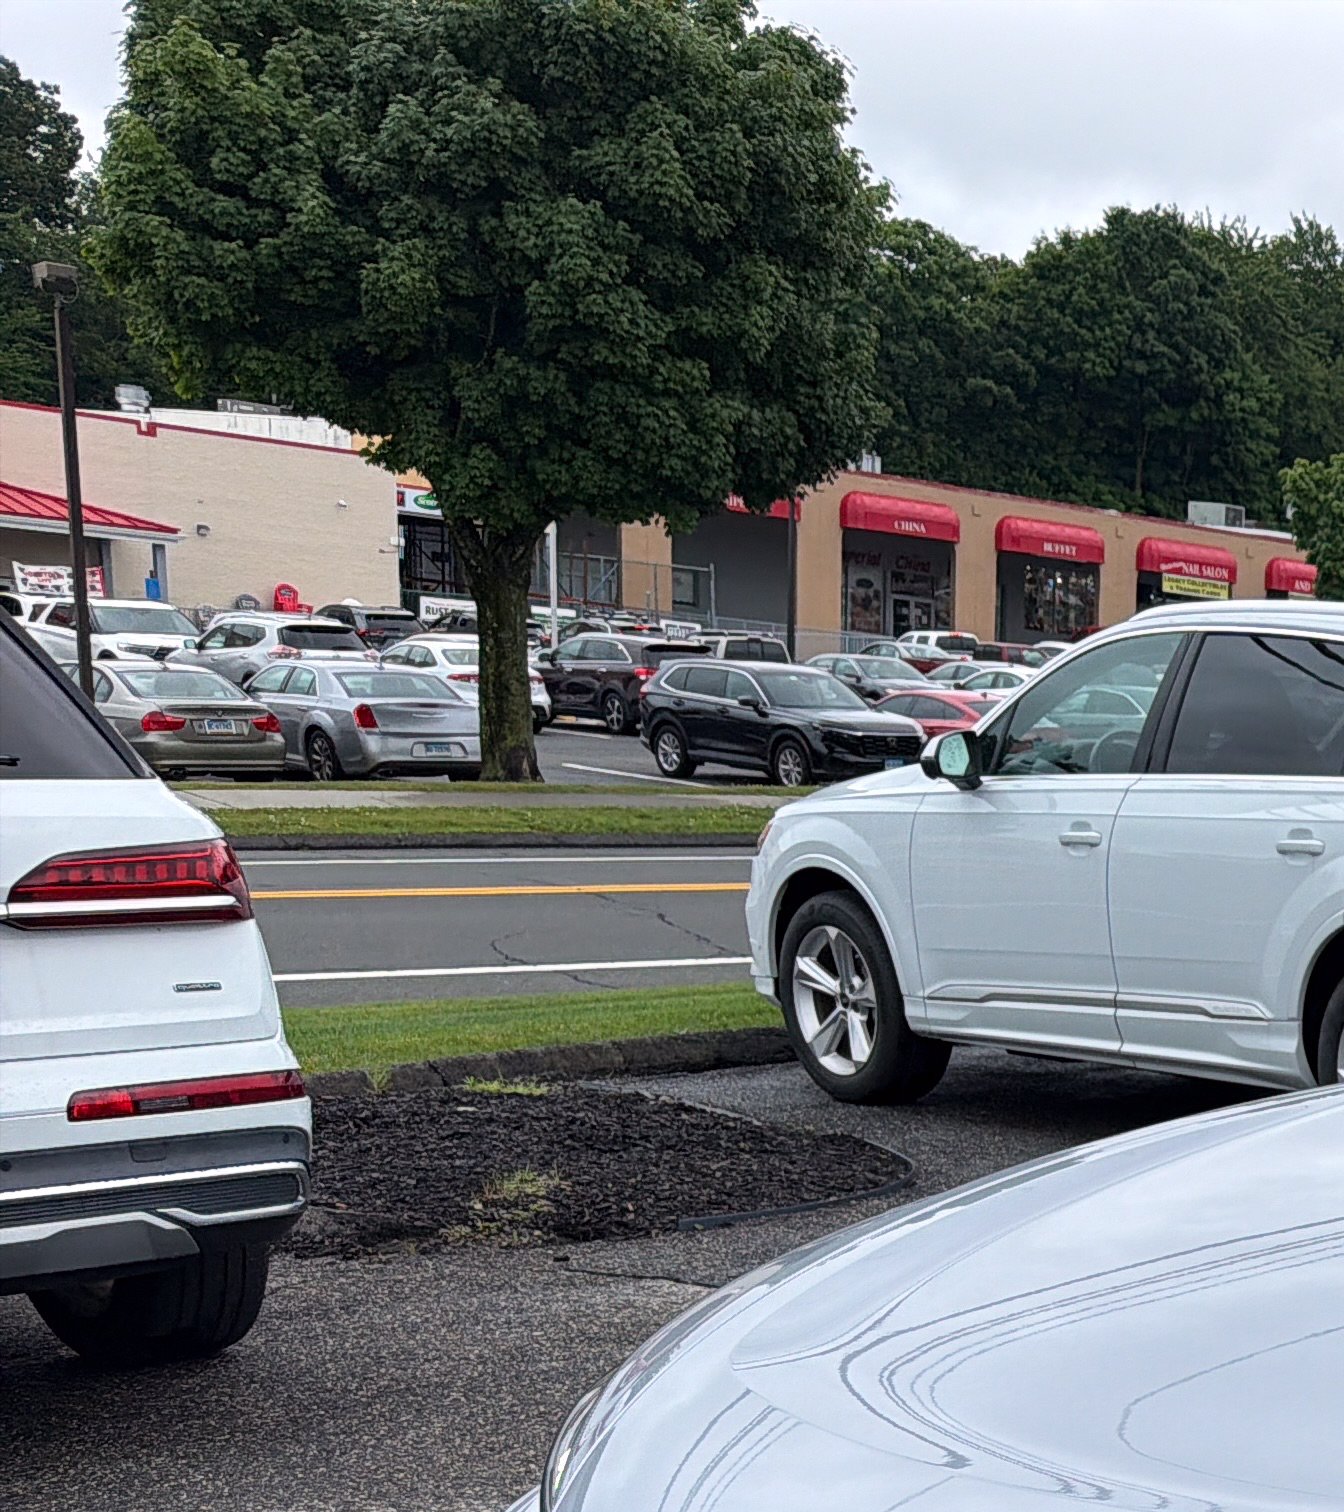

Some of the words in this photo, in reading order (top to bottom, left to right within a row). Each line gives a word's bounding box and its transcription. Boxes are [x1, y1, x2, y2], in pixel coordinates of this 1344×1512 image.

[893, 519, 927, 534] CHINA
[1043, 541, 1077, 557] BUFFET
[1182, 562, 1200, 576] NAIL
[1202, 564, 1229, 580] SALON
[1294, 580, 1311, 592] AND
